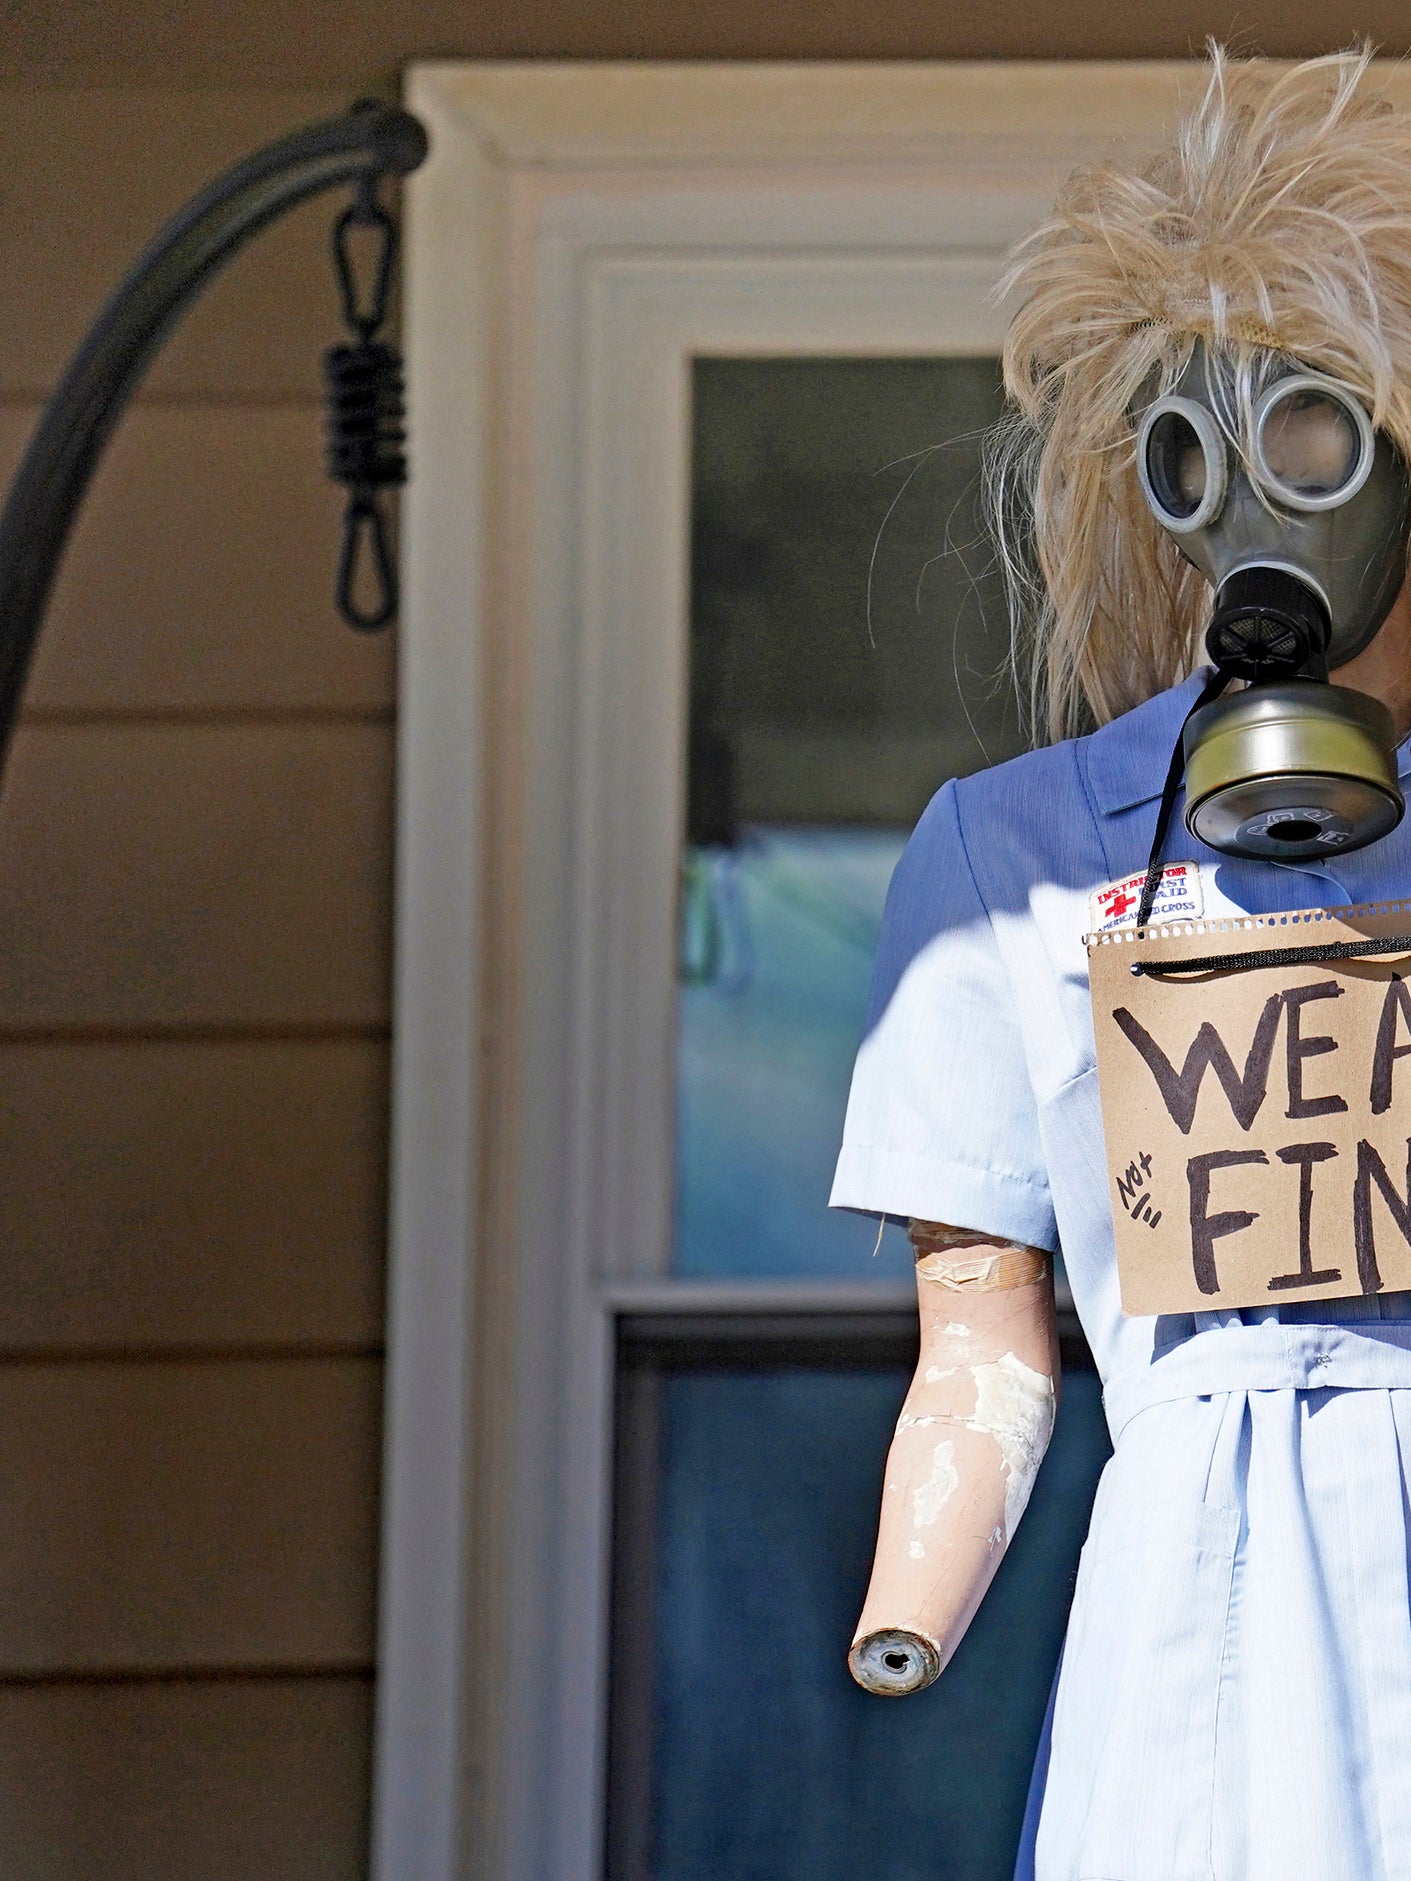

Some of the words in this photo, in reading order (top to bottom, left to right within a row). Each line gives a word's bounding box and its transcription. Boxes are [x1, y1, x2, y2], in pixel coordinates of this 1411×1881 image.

[1097, 866, 1188, 905] INSTRUTOR
[1161, 901, 1196, 914] CROSS
[1112, 980, 1348, 1134] WE
